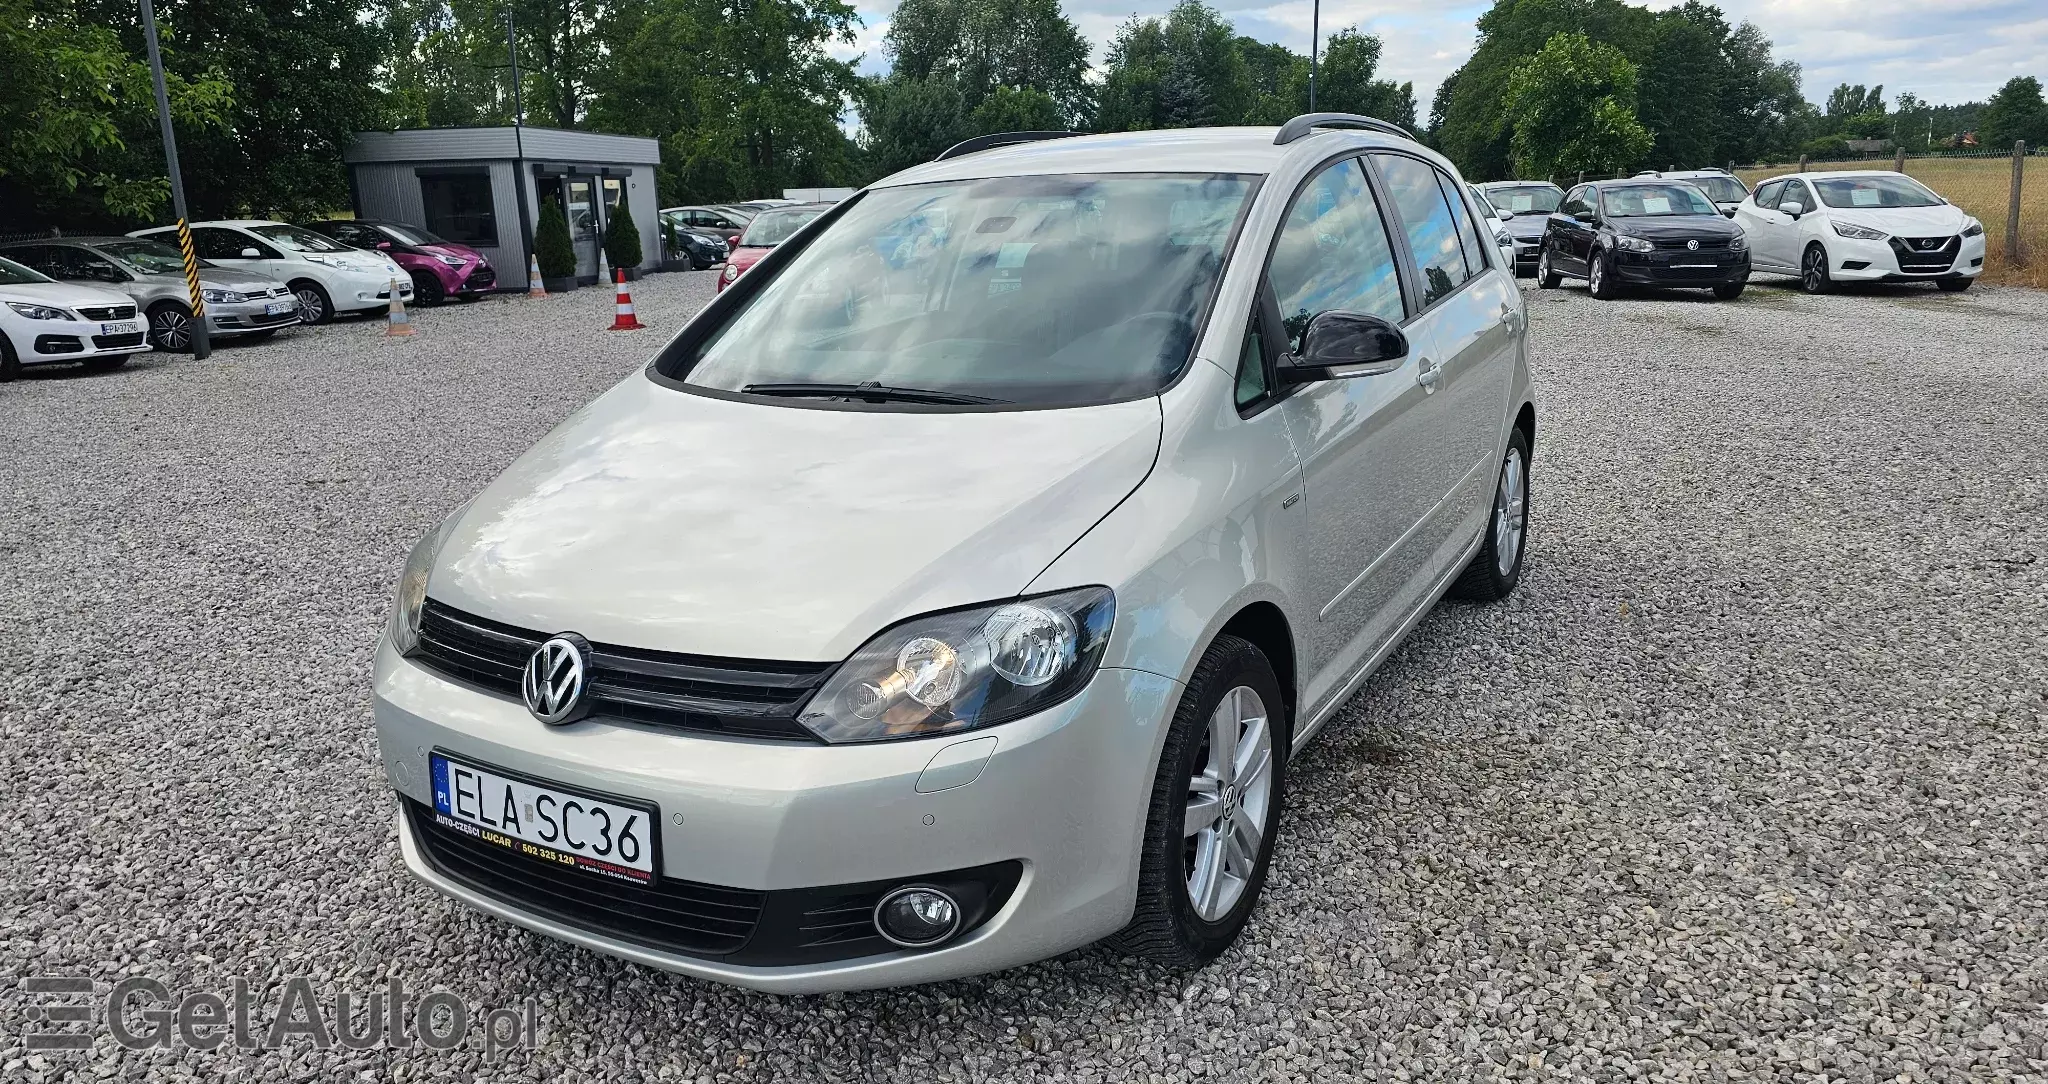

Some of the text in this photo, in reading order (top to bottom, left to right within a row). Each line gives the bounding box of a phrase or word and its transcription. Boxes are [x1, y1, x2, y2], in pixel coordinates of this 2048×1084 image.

[437, 790, 450, 807] PL
[454, 767, 641, 864] ELA SC36
[435, 813, 575, 866] AUTO-CZĘŚCI LUCAR 502 325 120
